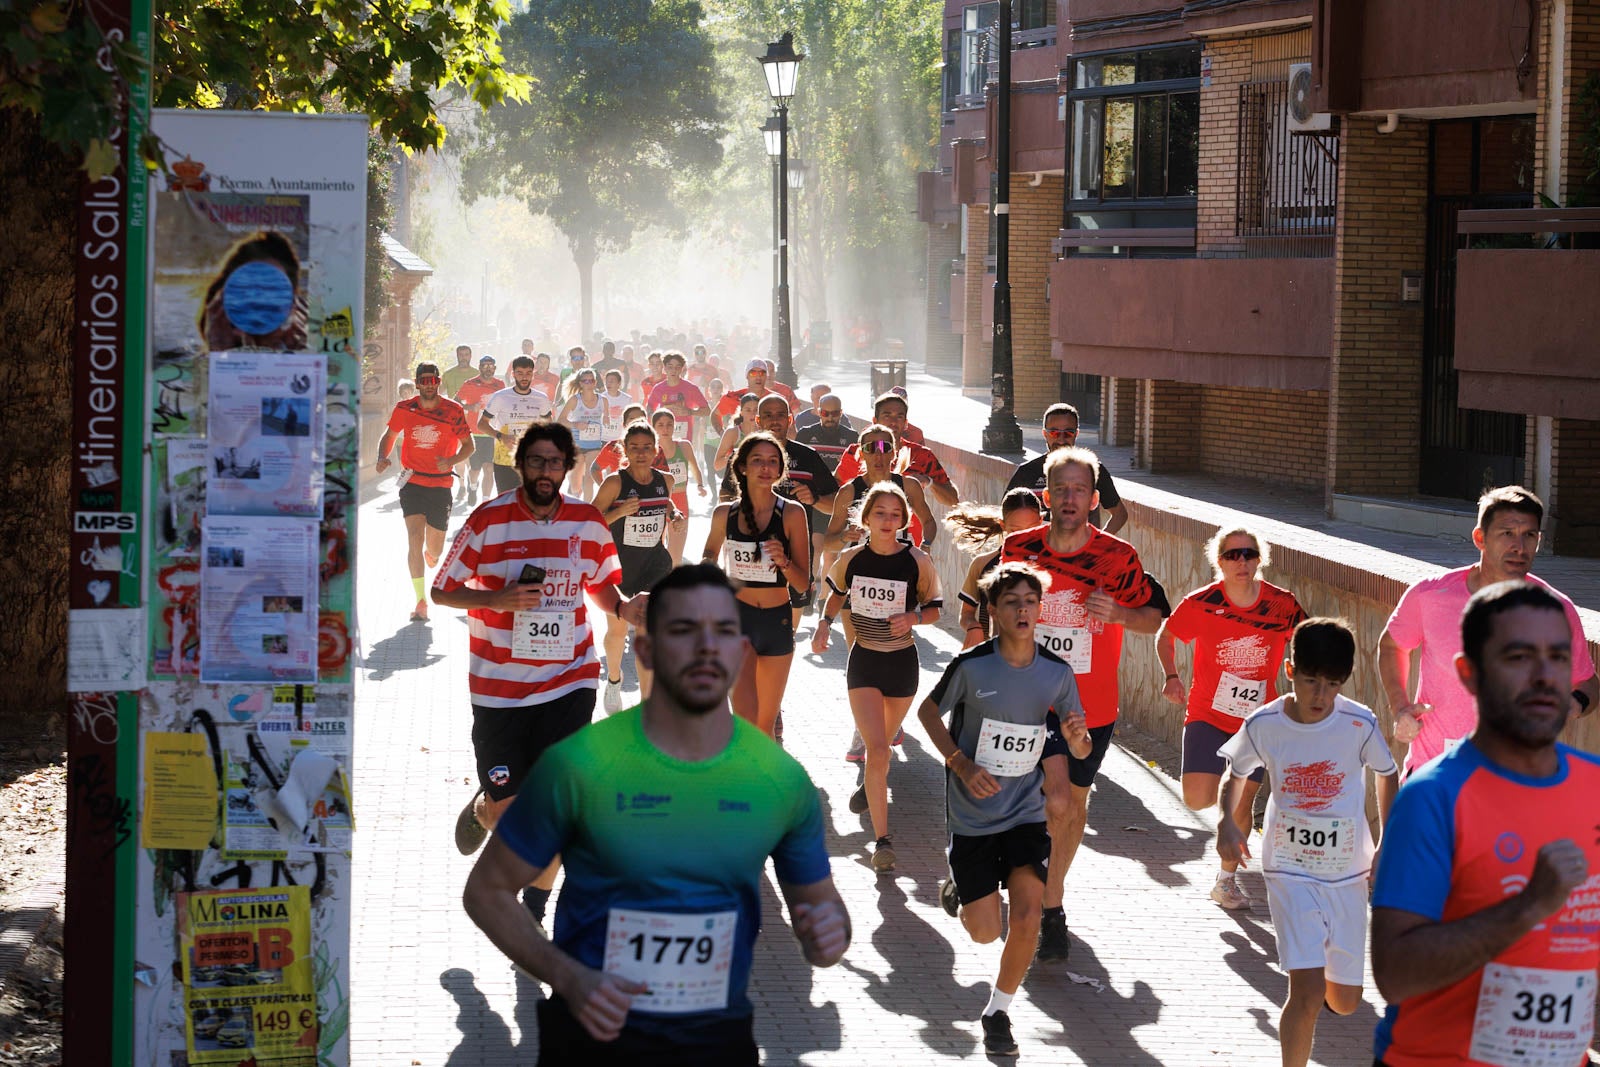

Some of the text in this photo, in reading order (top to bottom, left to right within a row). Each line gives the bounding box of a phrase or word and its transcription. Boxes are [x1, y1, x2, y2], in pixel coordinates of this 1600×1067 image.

[267, 176, 356, 193] Ayuntamiento
[130, 193, 143, 227] Ruta
[78, 514, 134, 530] MPS
[631, 522, 659, 533] 1360
[859, 586, 896, 602] 1039
[529, 622, 560, 637] 340
[1043, 635, 1073, 651] 700
[1218, 648, 1267, 658] carrera
[1231, 686, 1259, 703] 142
[261, 721, 292, 732] OFERTA
[992, 734, 1036, 752] 1651
[1285, 775, 1342, 786] carrera
[1286, 826, 1338, 848] 1301
[1302, 848, 1325, 857] ALONSO
[199, 950, 250, 962] PERMISO
[258, 927, 295, 969] B
[628, 933, 715, 965] 1779
[222, 996, 257, 1008] CLASES
[1512, 991, 1574, 1024] 381
[255, 1008, 314, 1032] 149 €
